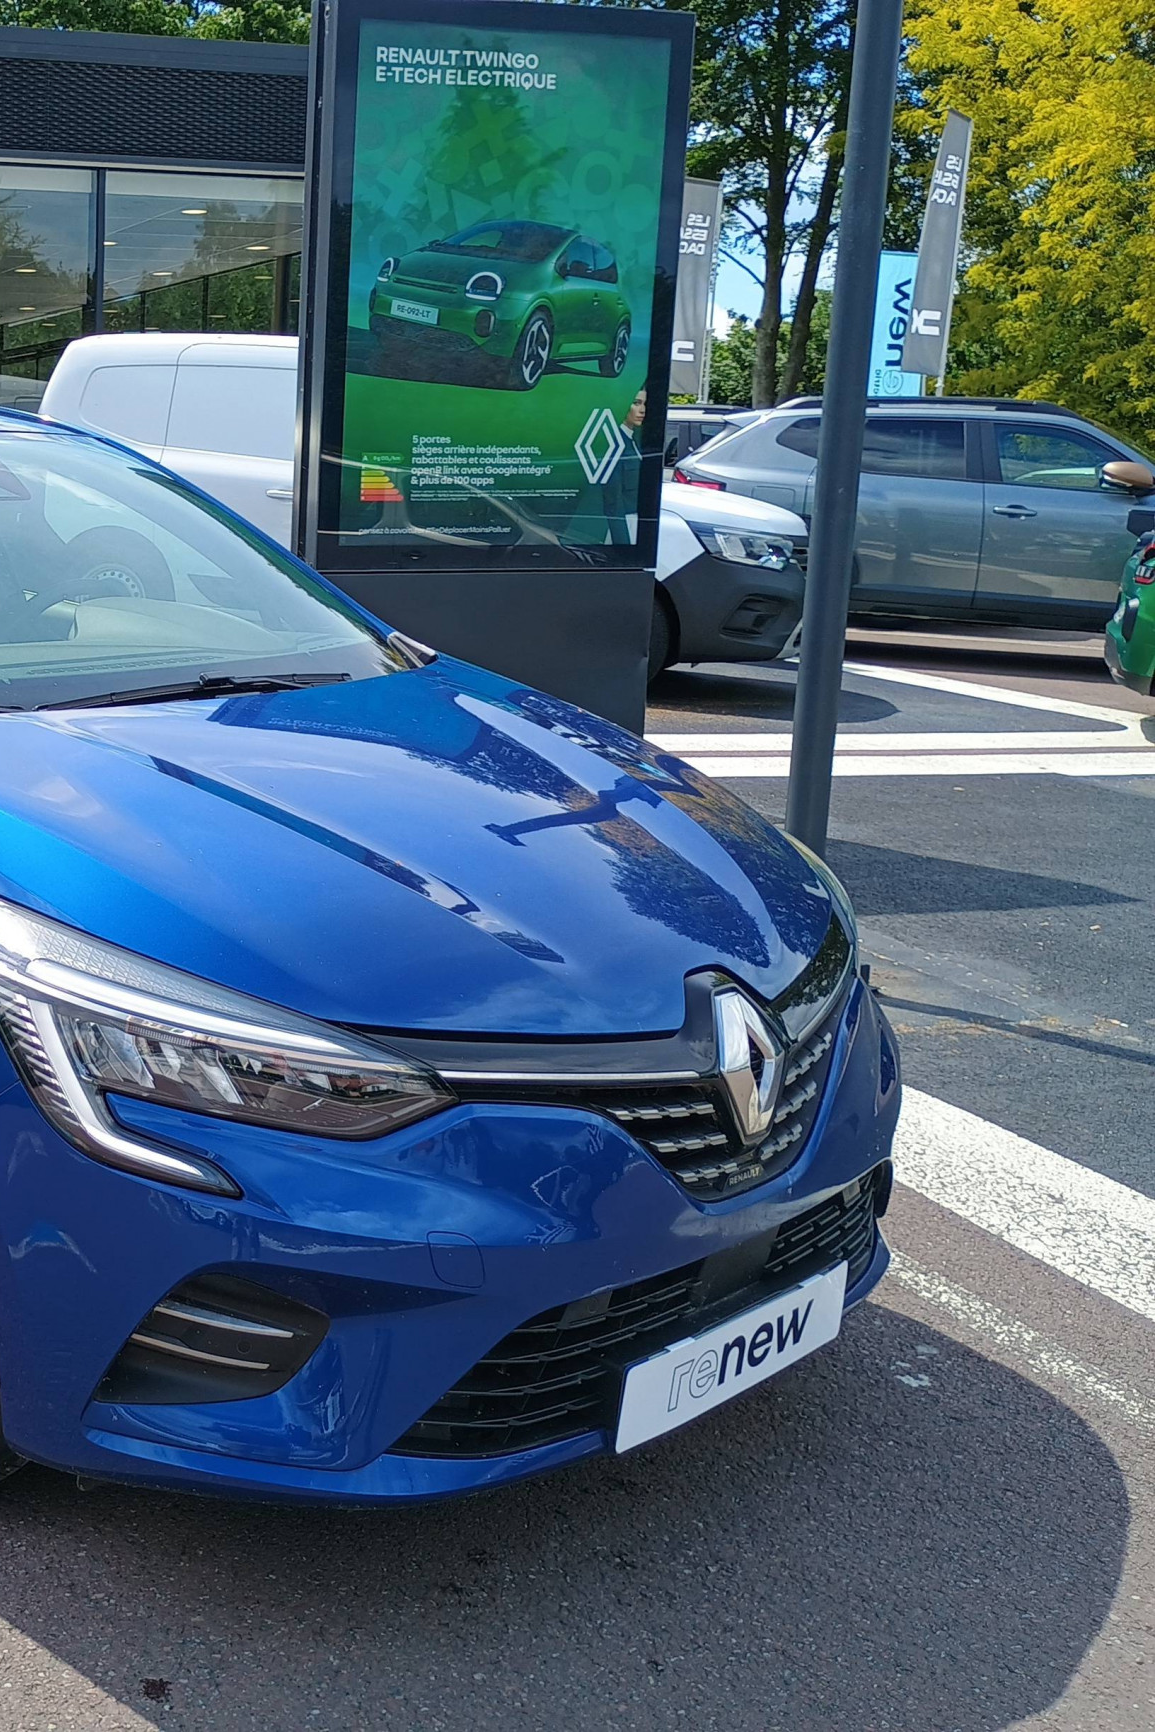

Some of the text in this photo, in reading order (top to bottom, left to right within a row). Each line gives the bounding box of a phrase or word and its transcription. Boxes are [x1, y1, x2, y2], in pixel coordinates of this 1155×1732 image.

[376, 46, 539, 69] RENAULT TWINGO
[375, 66, 557, 90] E-TECH ELECTRIQUE
[412, 435, 451, 446] 5 portes
[412, 444, 542, 456] sièges arrière indépendants,
[412, 454, 532, 465] rabattables et coulissants
[443, 465, 460, 475] link
[461, 467, 484, 475] avec
[484, 466, 517, 477] Google
[411, 476, 419, 485] &
[419, 475, 440, 486] plus
[454, 477, 470, 485] 100
[470, 478, 495, 488] apps
[729, 1167, 760, 1186] RENAULT
[667, 1299, 814, 1413] renew
